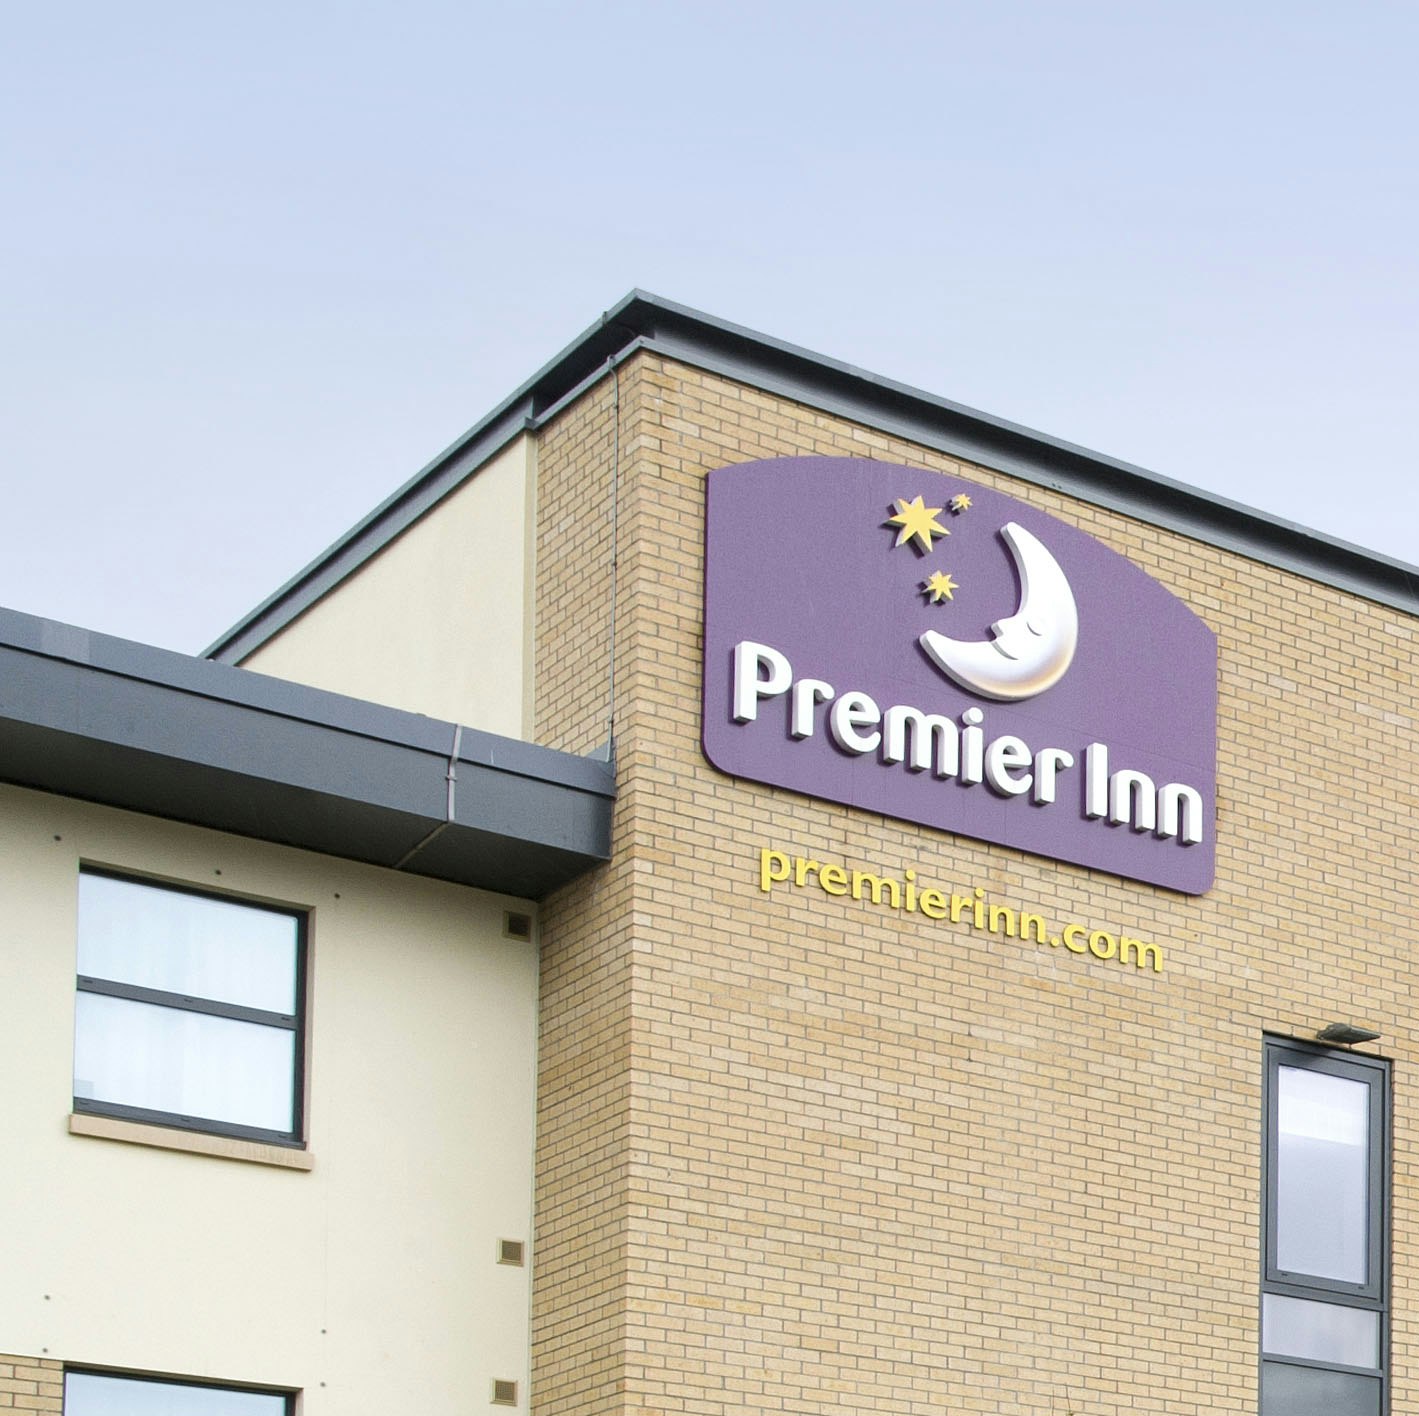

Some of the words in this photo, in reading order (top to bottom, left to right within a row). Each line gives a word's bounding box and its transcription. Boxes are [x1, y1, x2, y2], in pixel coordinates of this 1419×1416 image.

[732, 640, 1074, 804] Premier
[1085, 742, 1204, 845] Inn
[759, 847, 1164, 972] premierinn.com
